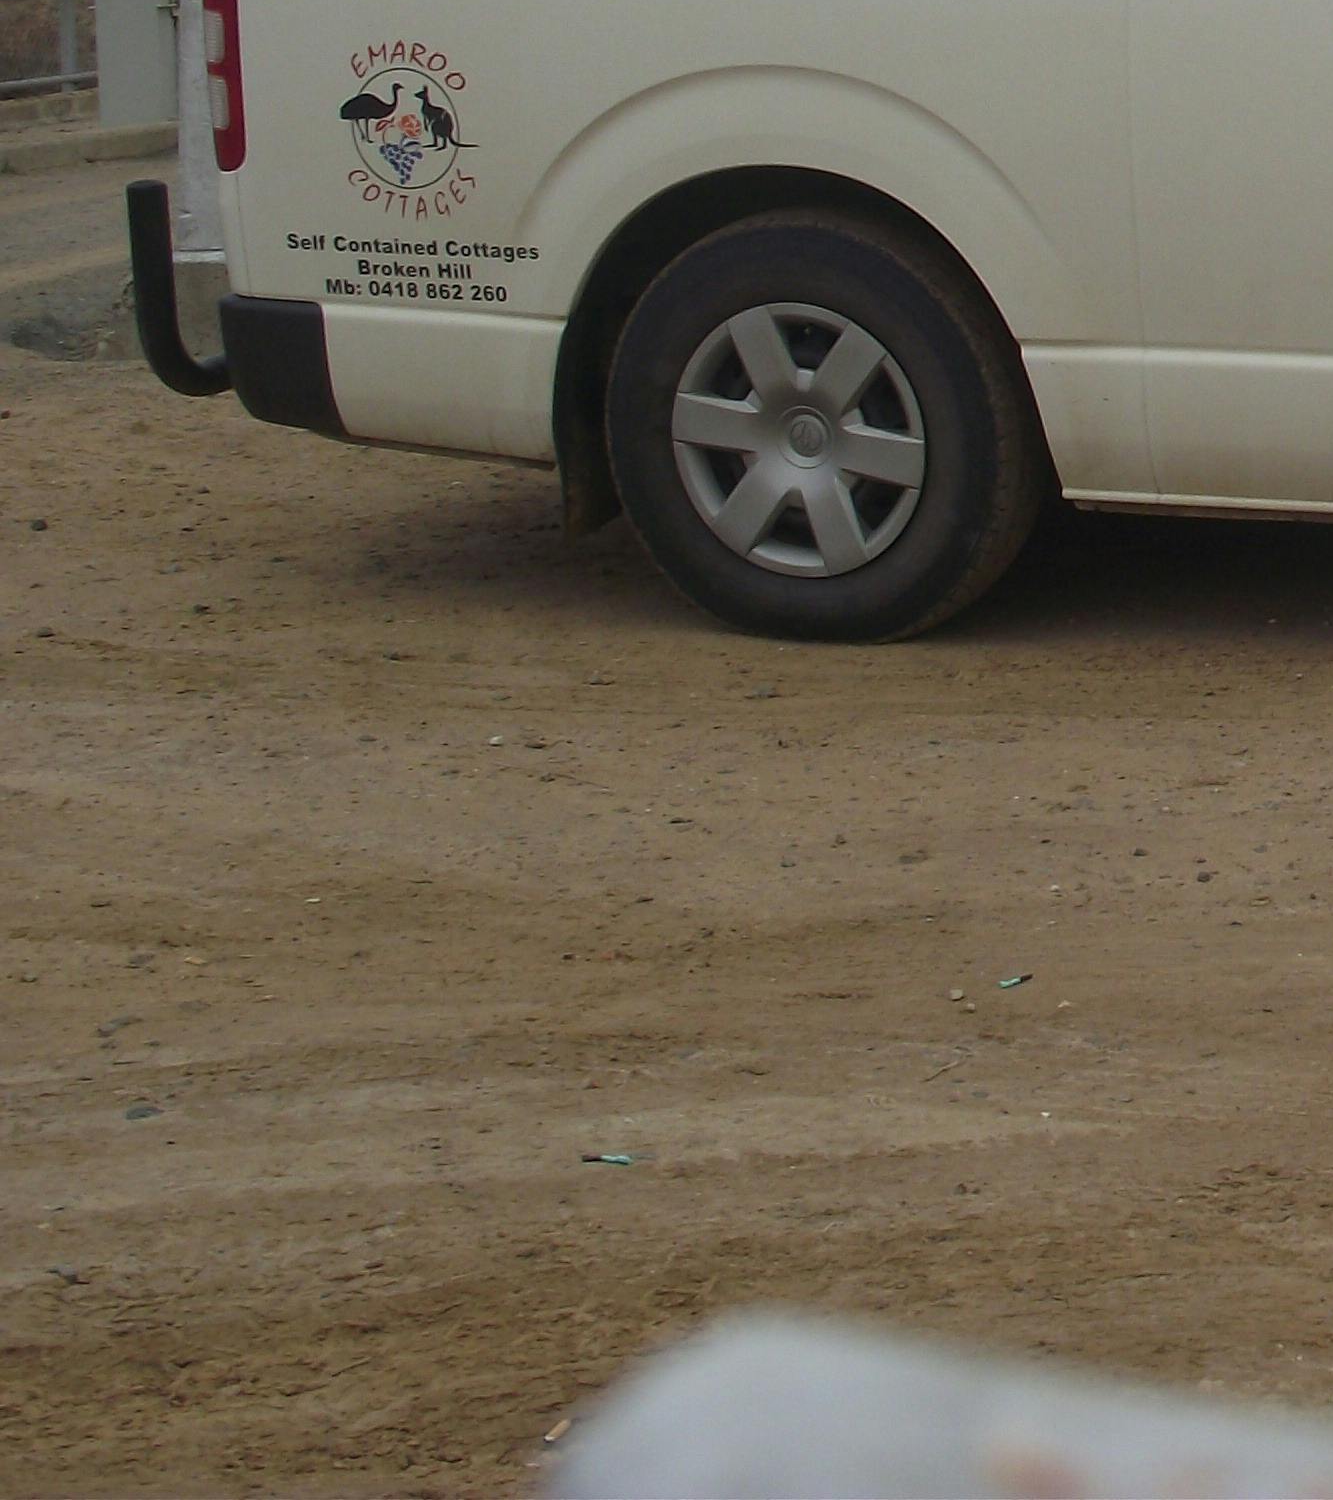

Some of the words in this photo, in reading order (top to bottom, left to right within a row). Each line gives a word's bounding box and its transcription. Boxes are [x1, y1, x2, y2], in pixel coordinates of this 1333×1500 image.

[350, 39, 467, 91] EMAROO
[348, 168, 477, 221] COTTAGES
[286, 233, 326, 251] Self
[333, 236, 438, 257] Contained
[445, 240, 540, 263] Cottages
[357, 259, 430, 278] Broken
[438, 262, 472, 280] Hill
[326, 278, 362, 296] Mb:
[369, 280, 418, 299] 0418
[427, 282, 464, 301] 862
[471, 284, 508, 303] 260
